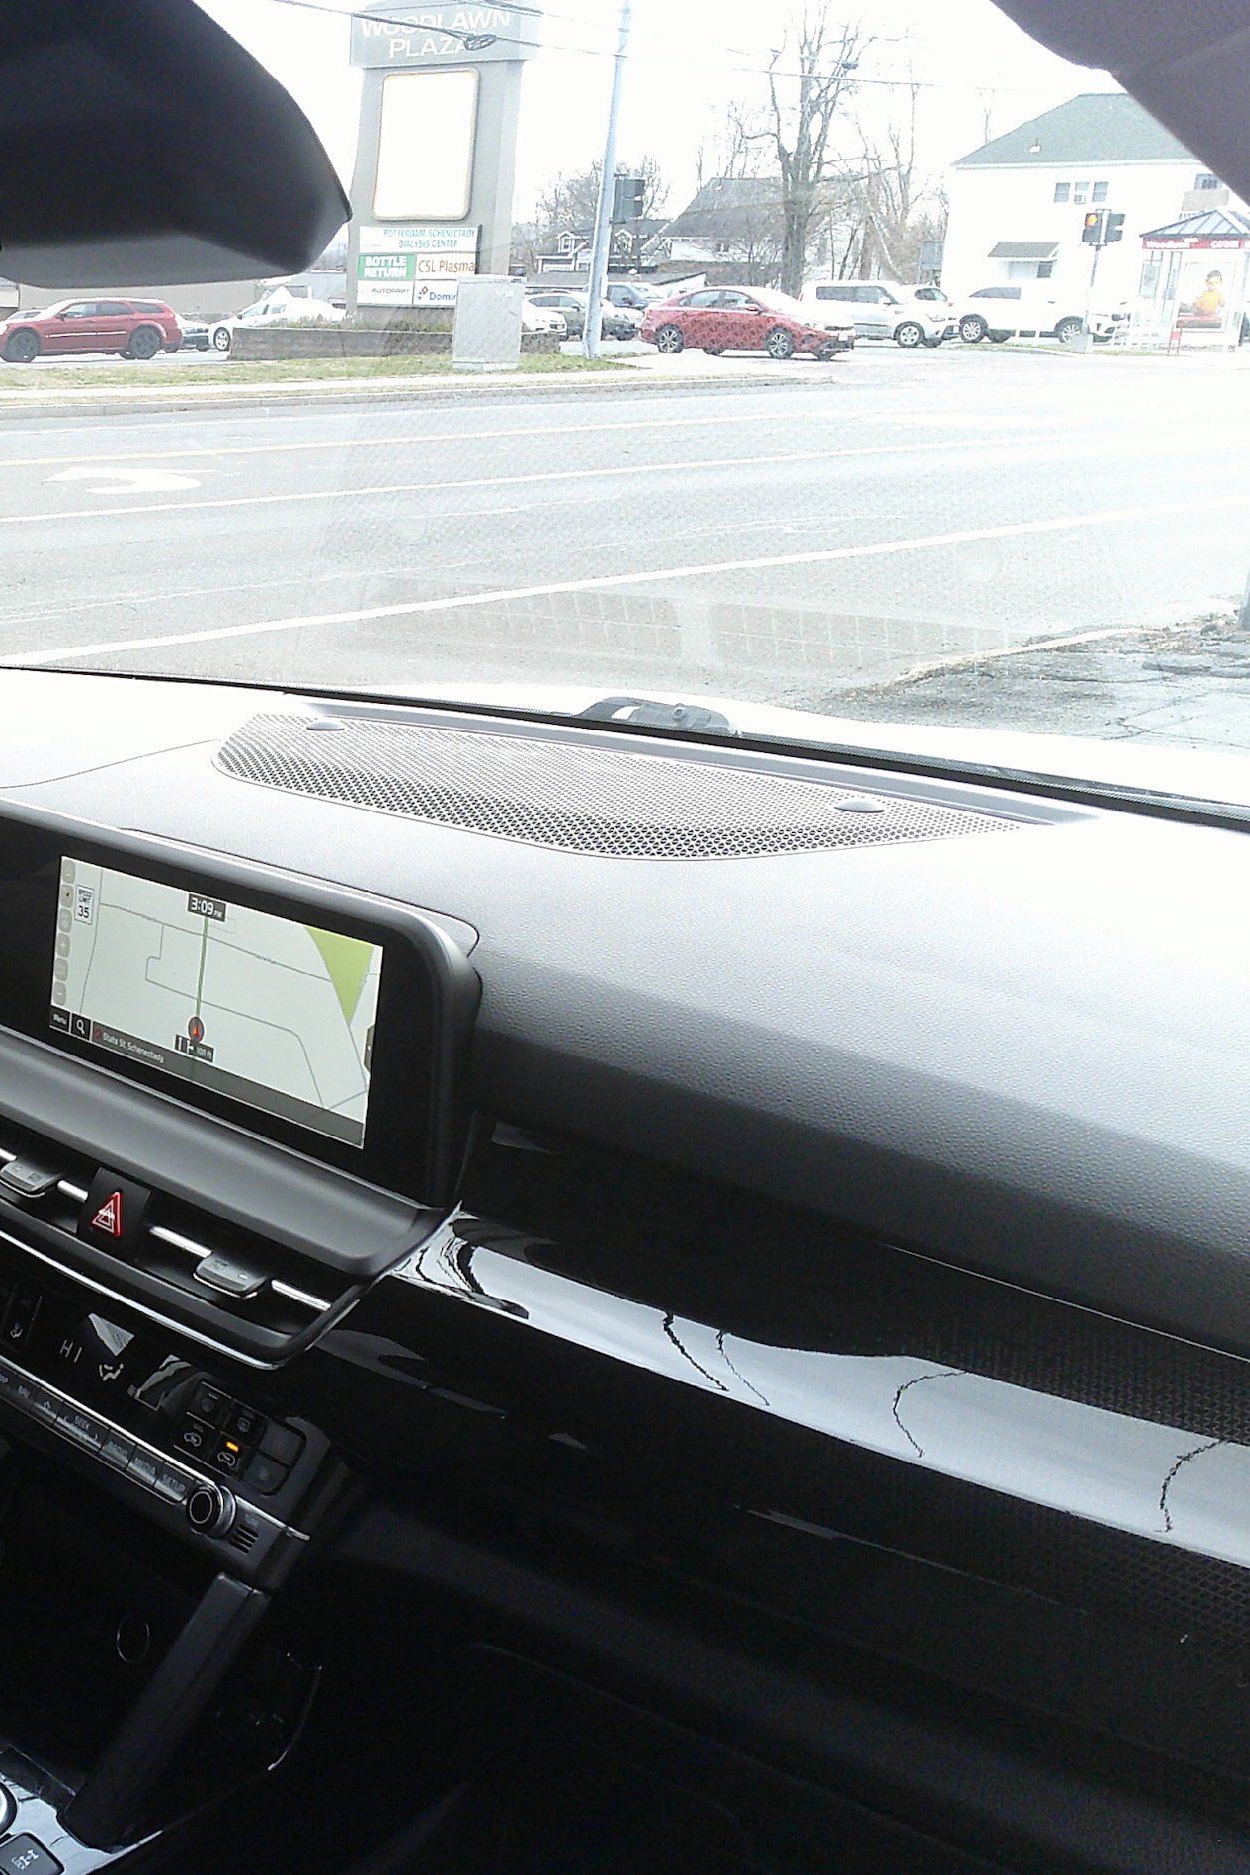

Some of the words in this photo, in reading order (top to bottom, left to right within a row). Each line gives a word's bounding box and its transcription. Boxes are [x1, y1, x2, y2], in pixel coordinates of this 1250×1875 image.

[362, 11, 510, 37] WOODLAWN
[365, 255, 407, 266] BOTTLE
[418, 260, 436, 273] CSL
[439, 260, 476, 273] Plasma
[78, 905, 90, 919] 35
[190, 897, 214, 916] 3:09
[59, 1339, 83, 1364] HI
[162, 1473, 187, 1493] SETUP
